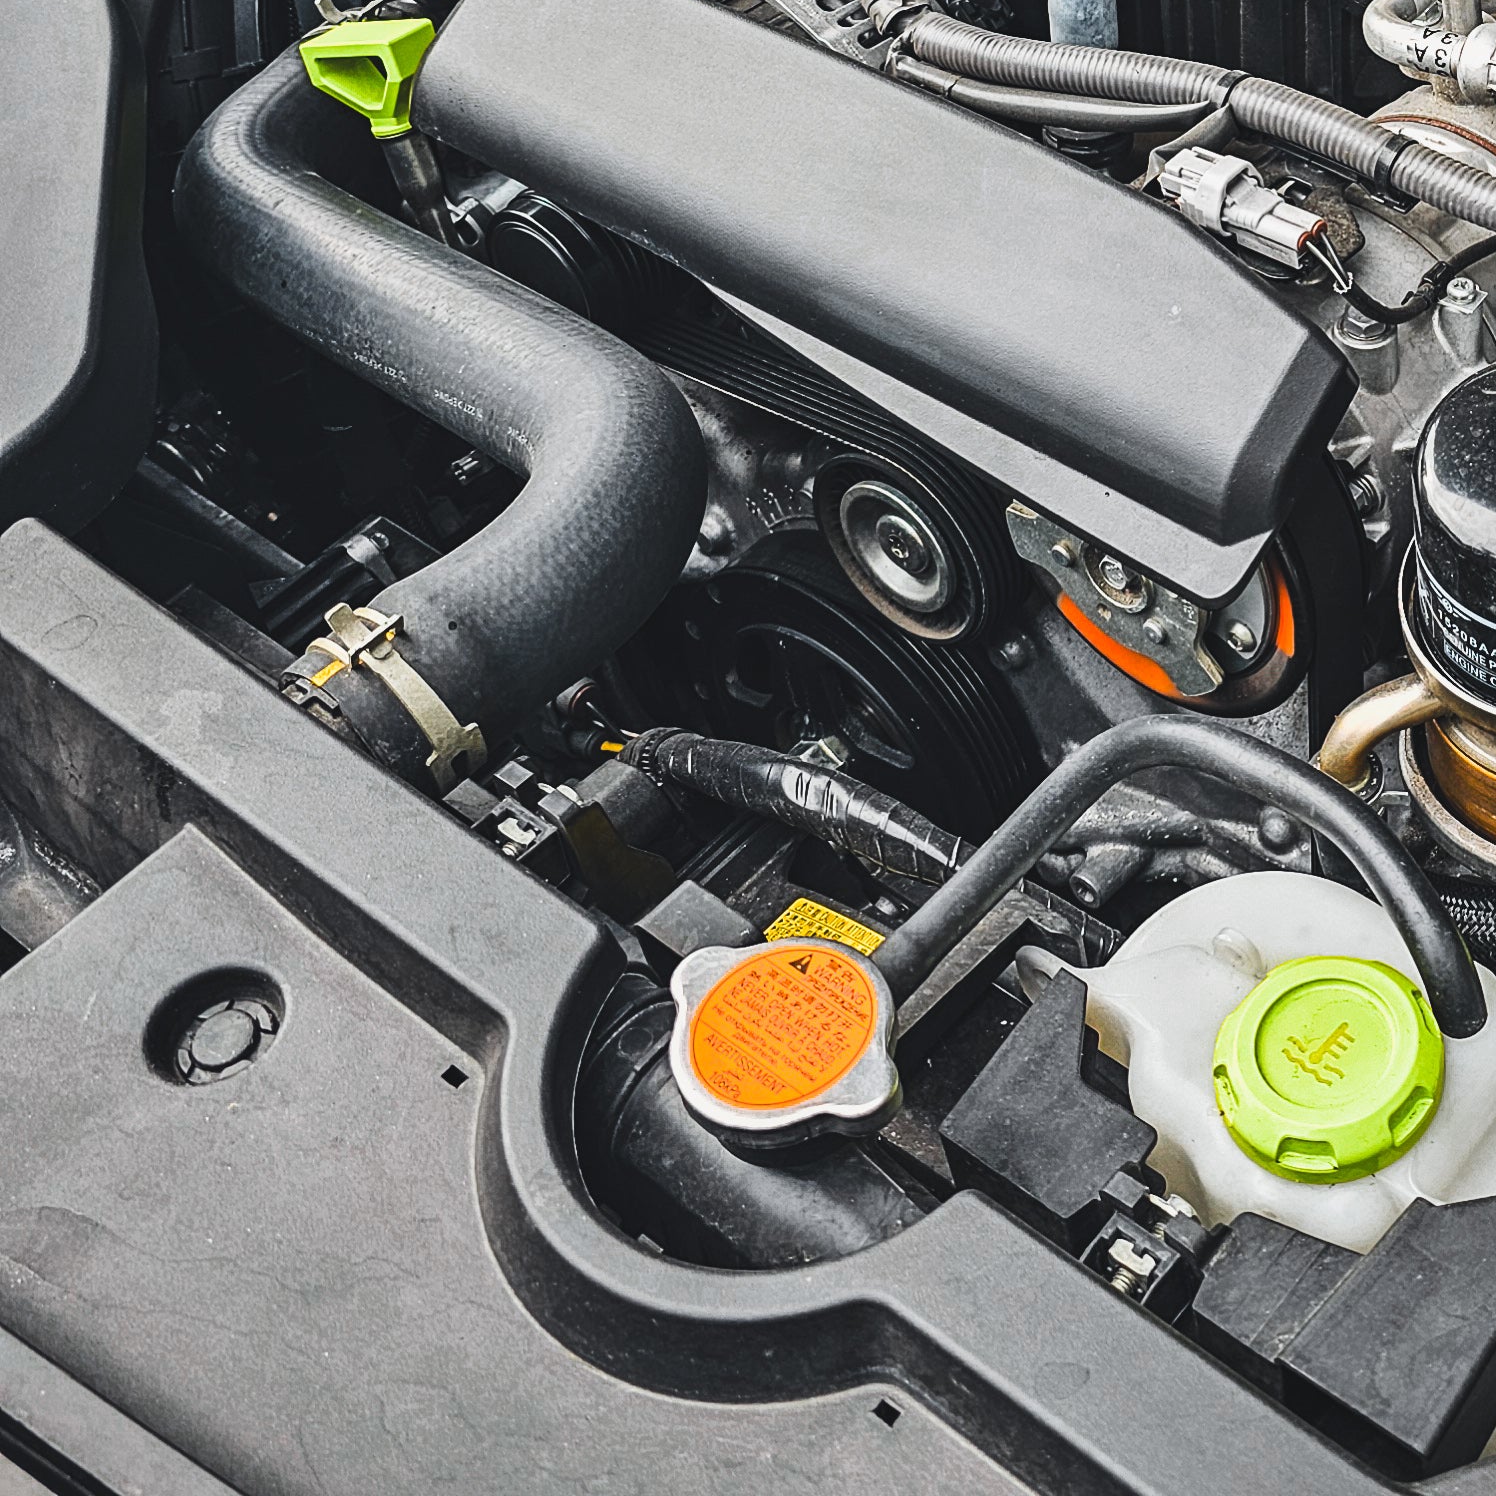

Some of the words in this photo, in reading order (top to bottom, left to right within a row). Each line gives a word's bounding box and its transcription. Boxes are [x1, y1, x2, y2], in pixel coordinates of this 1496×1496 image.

[1445, 646, 1487, 682] ENGINE
[739, 978, 769, 1003] NEVER
[769, 999, 792, 1020] OPEN
[795, 1017, 823, 1040] WHEN
[814, 966, 866, 1006] WARNING
[702, 1032, 788, 1095] AVERTISSEMENT
